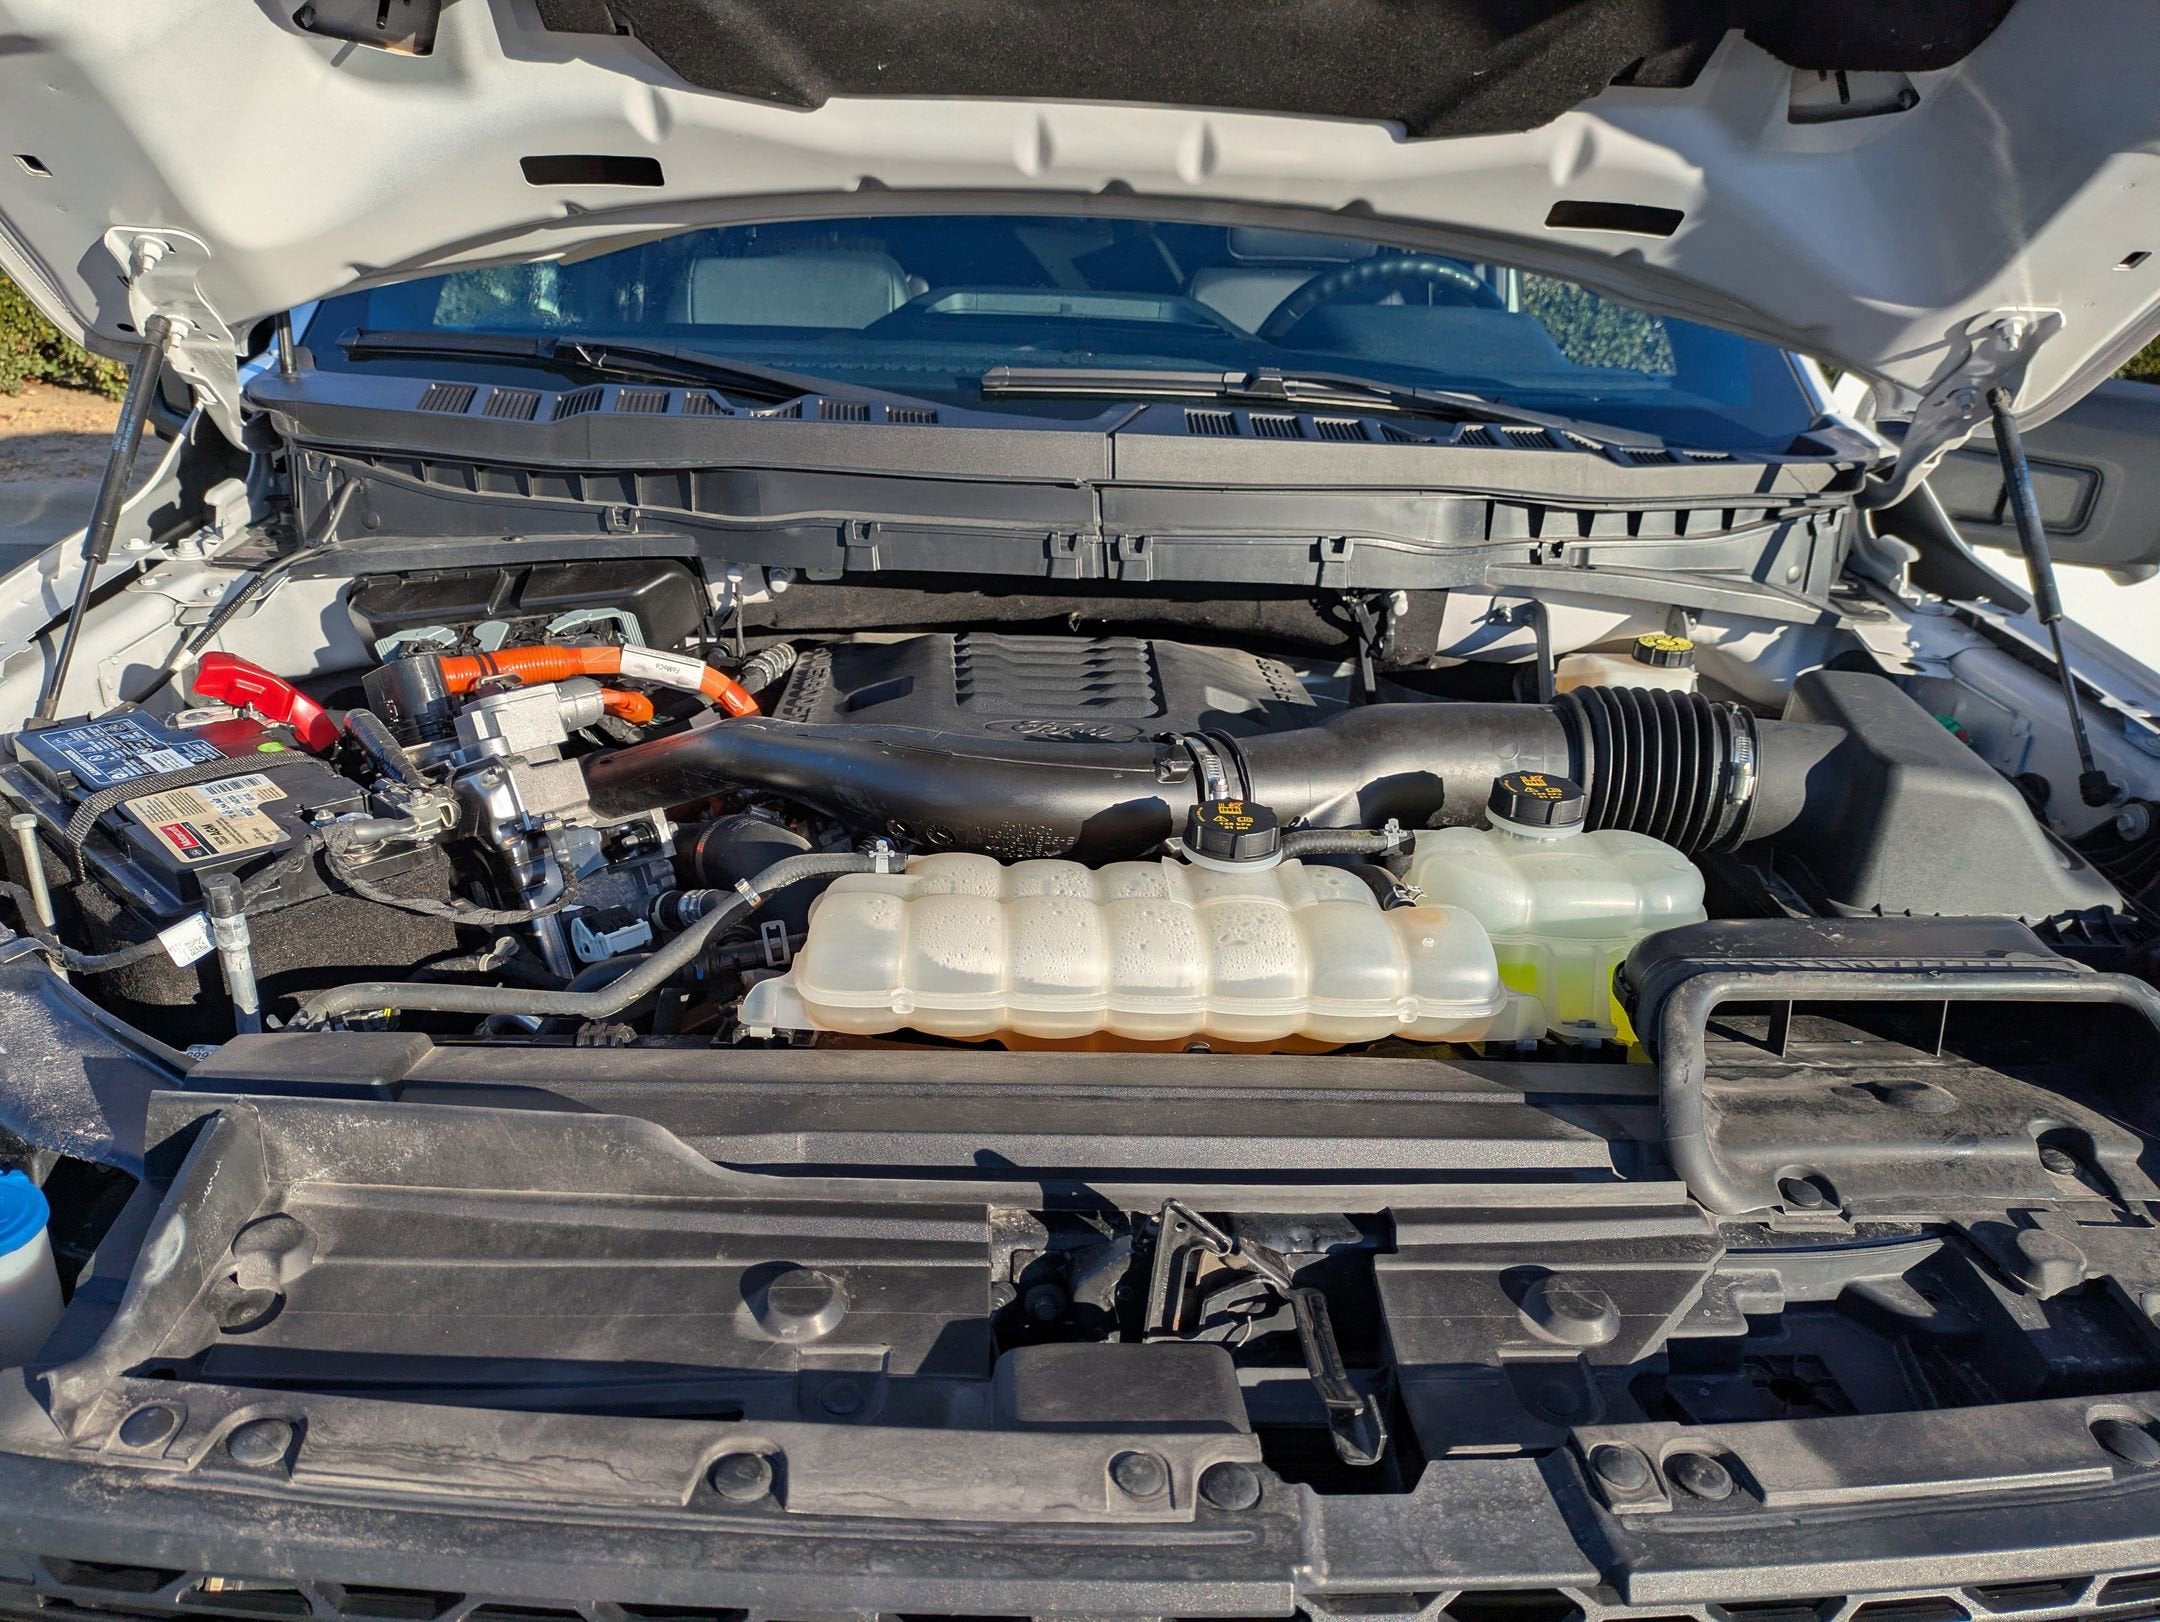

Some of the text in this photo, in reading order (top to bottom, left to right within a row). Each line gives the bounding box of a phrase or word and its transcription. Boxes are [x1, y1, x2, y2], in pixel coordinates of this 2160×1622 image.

[656, 663, 680, 674] FoMoCo
[1011, 719, 1116, 739] Ford
[166, 825, 194, 847] Motorcraft
[202, 823, 222, 836] AGM
